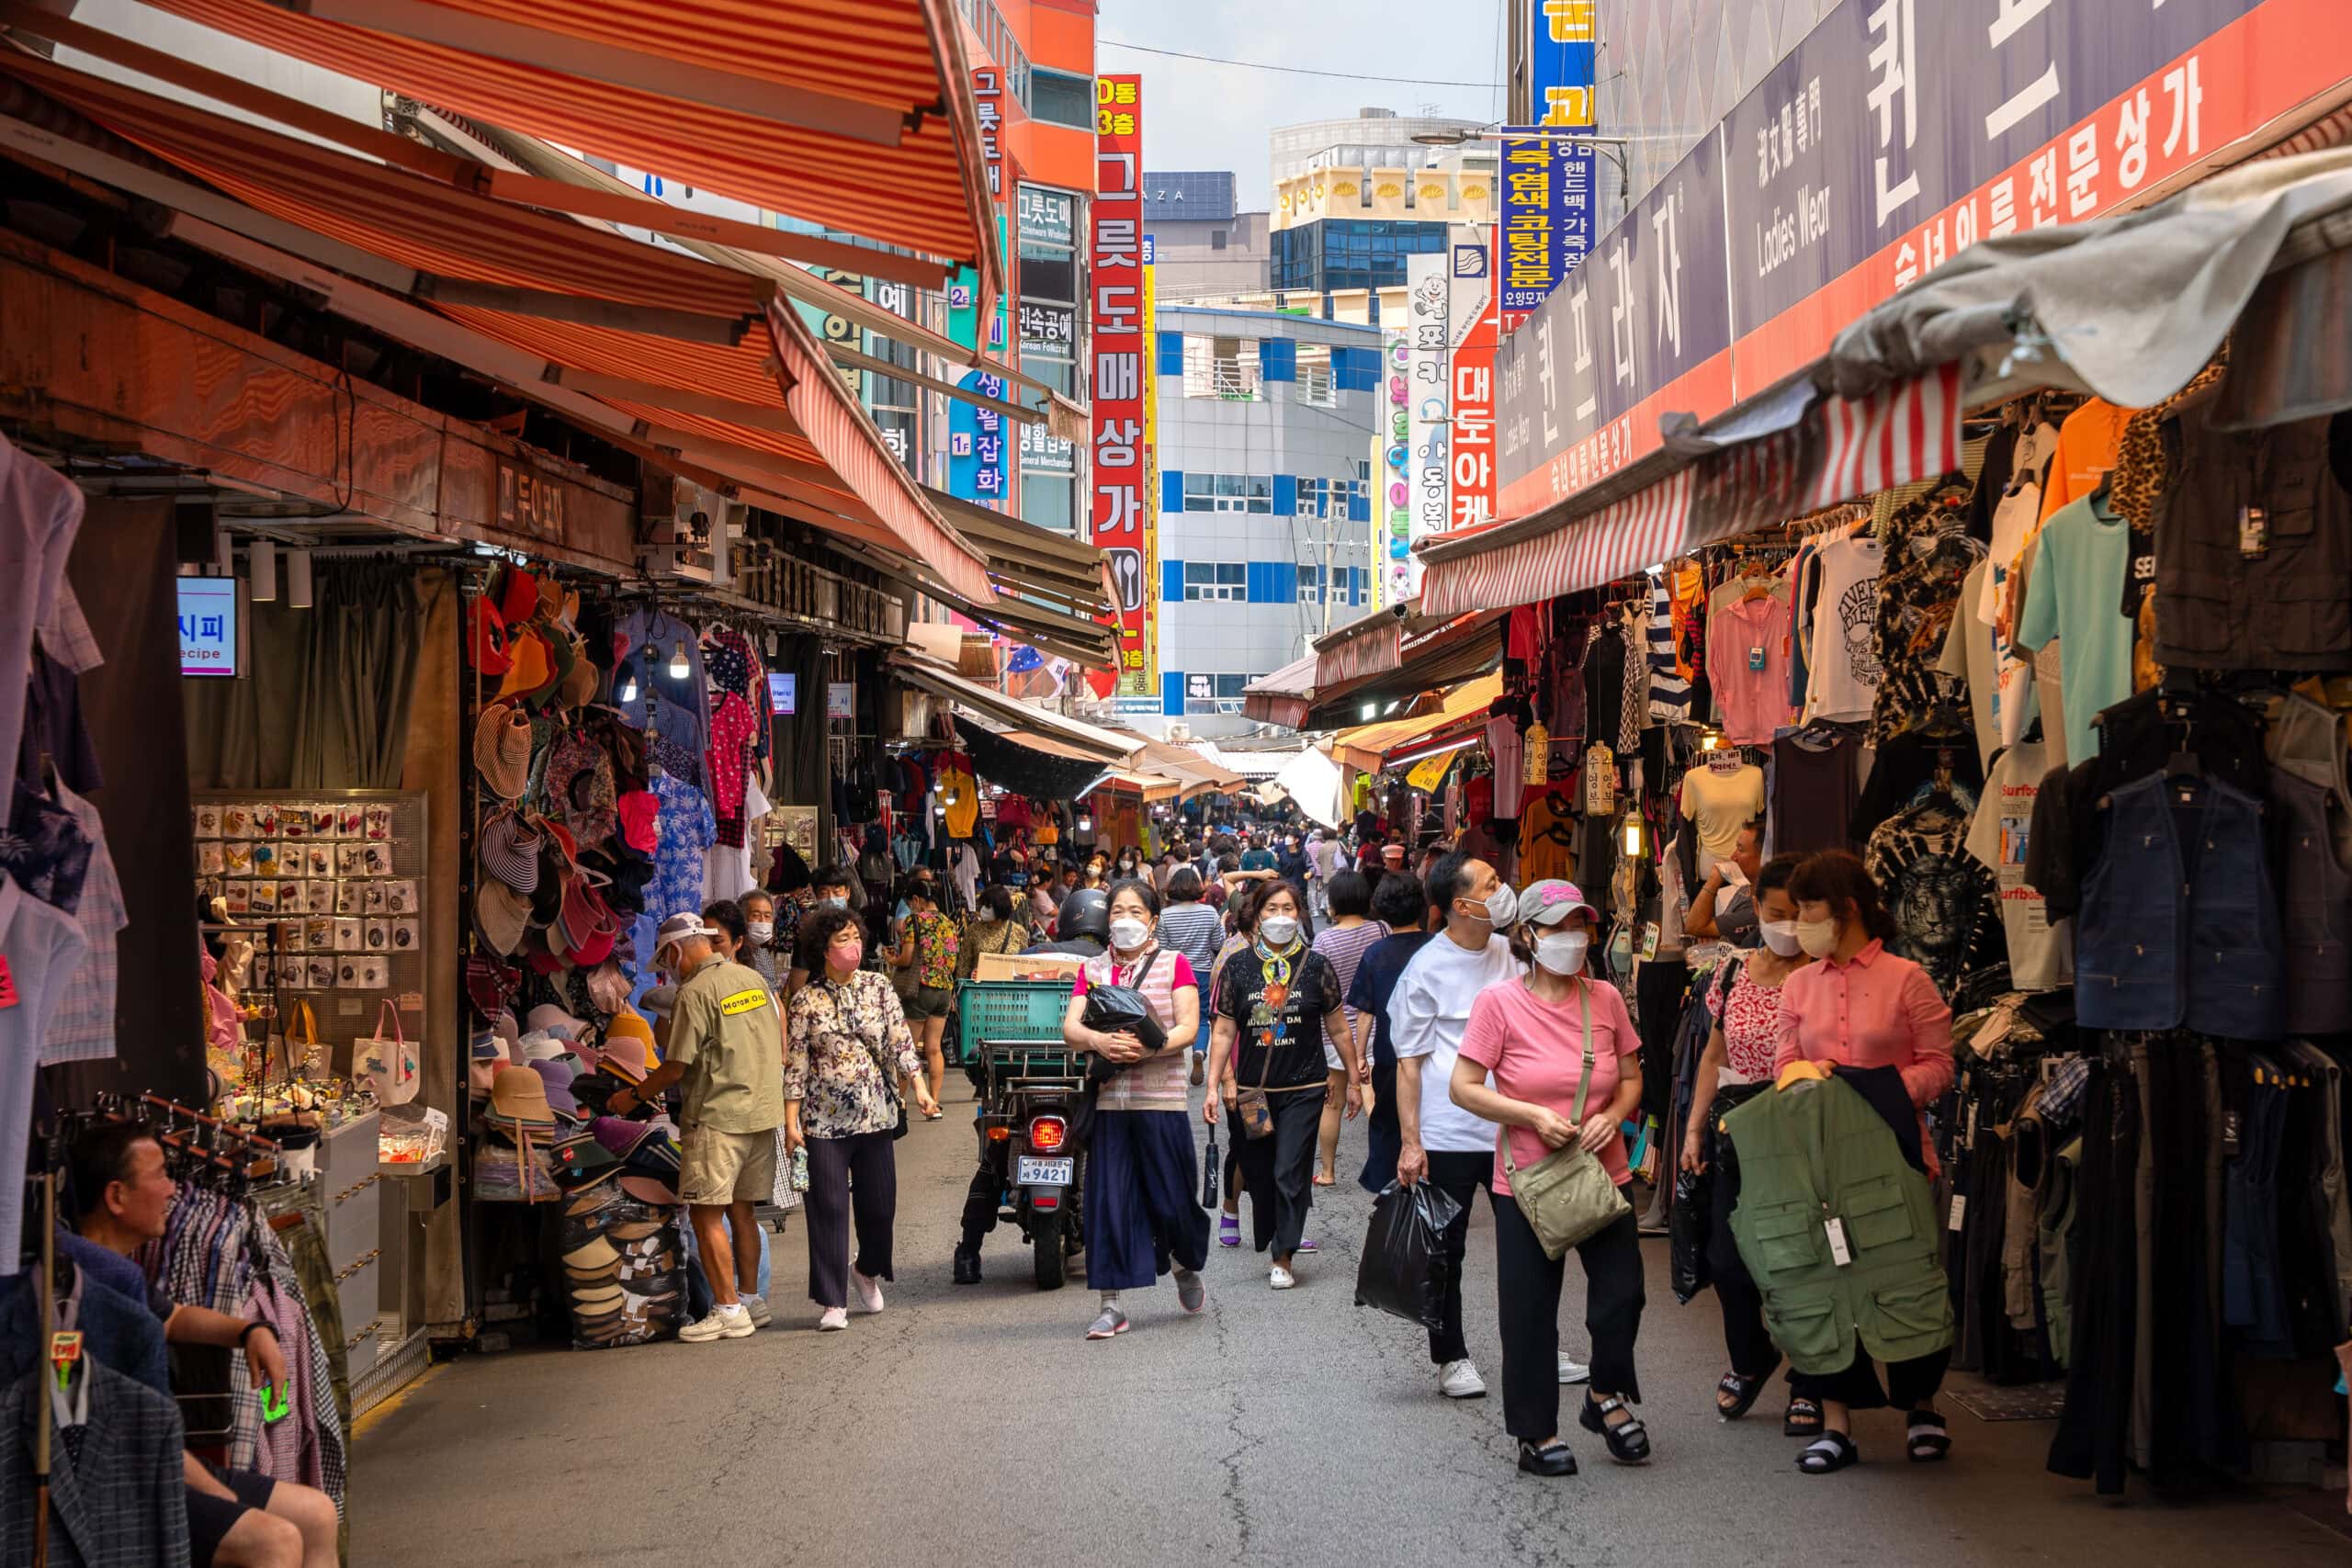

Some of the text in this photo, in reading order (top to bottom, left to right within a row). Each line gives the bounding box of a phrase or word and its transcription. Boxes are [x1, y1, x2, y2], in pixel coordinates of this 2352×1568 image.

[1020, 194, 1070, 228] 그릇도매
[1757, 184, 1830, 278] Ladies Wear
[952, 289, 968, 306] 2F
[1020, 307, 1072, 343] 민속공예
[1538, 194, 1681, 448] 퀸프라자
[1097, 152, 1141, 533] 그릇도매상가
[955, 434, 970, 452] 1F
[976, 369, 1004, 494] 생활잡화
[1588, 755, 1600, 807] 수영복
[723, 994, 765, 1010] MOTOR OIL
[1033, 1168, 1067, 1181] 9421
[1791, 1402, 1816, 1413] FILA
